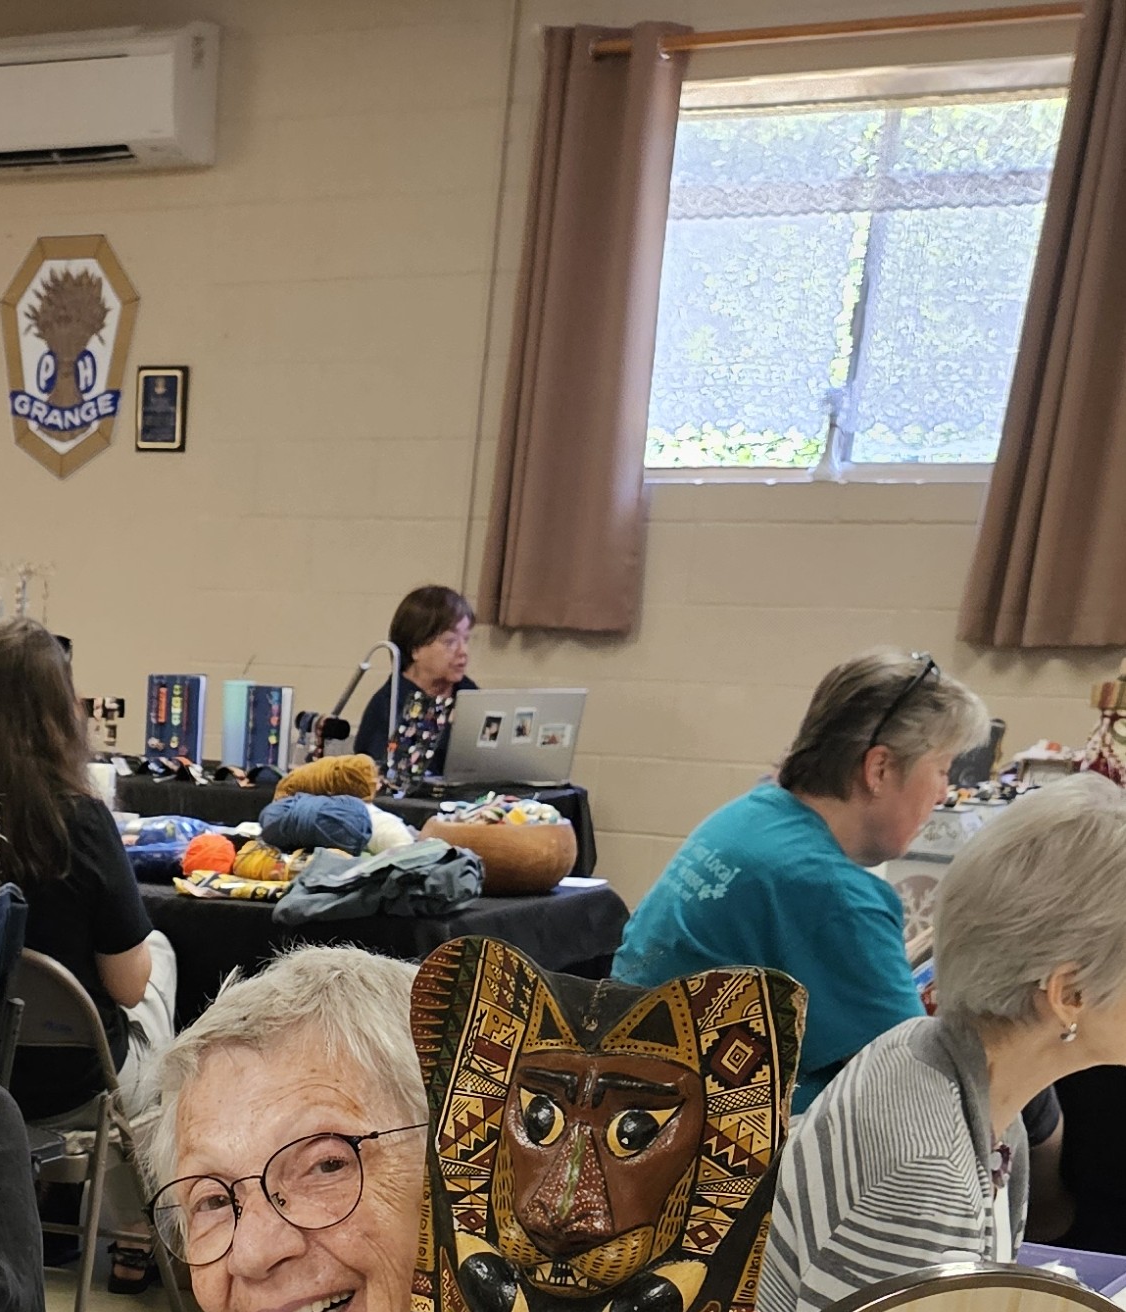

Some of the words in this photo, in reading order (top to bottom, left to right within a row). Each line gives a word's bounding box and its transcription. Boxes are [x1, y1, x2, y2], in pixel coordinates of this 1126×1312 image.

[38, 354, 56, 390] P
[77, 356, 95, 390] H
[12, 393, 116, 430] GRANGE
